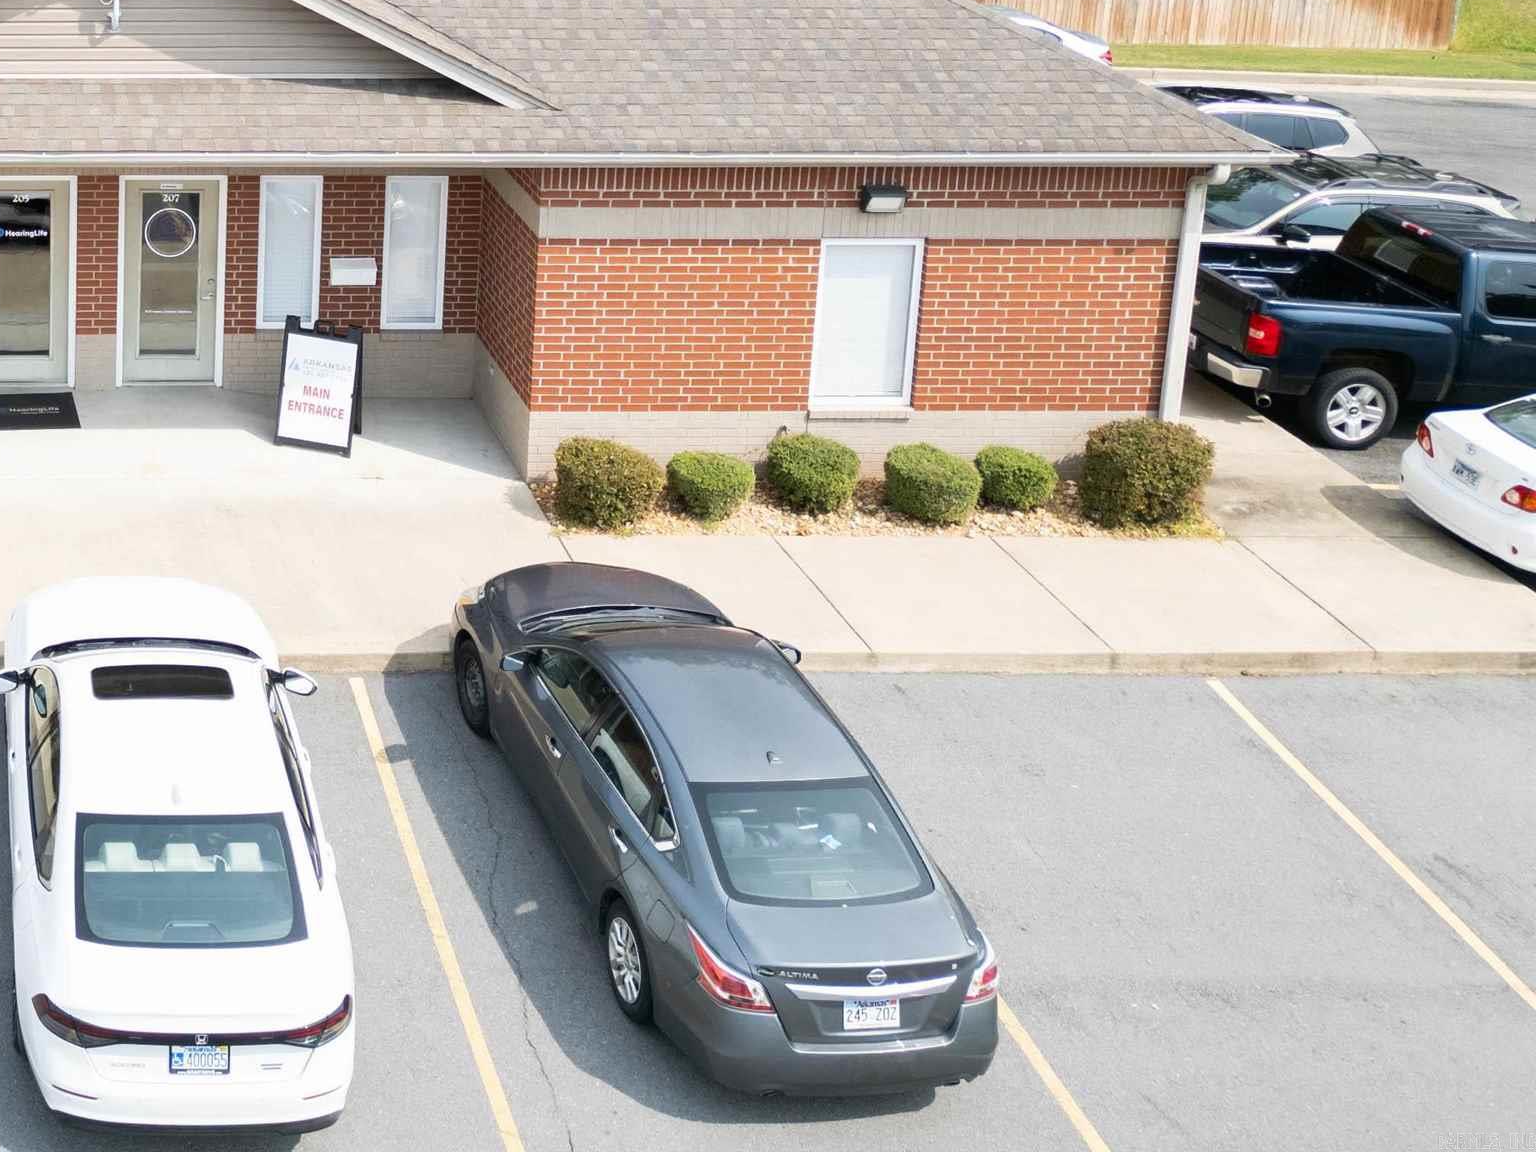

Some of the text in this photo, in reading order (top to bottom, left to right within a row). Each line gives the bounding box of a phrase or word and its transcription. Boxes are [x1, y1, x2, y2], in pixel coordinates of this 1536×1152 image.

[12, 194, 30, 203] 205
[162, 193, 180, 202] 207
[5, 229, 48, 238] HearingLife
[303, 385, 330, 400] MAIN
[288, 399, 344, 420] ENTRANCE
[777, 970, 819, 980] ALTIMA
[847, 1008, 868, 1023] 245
